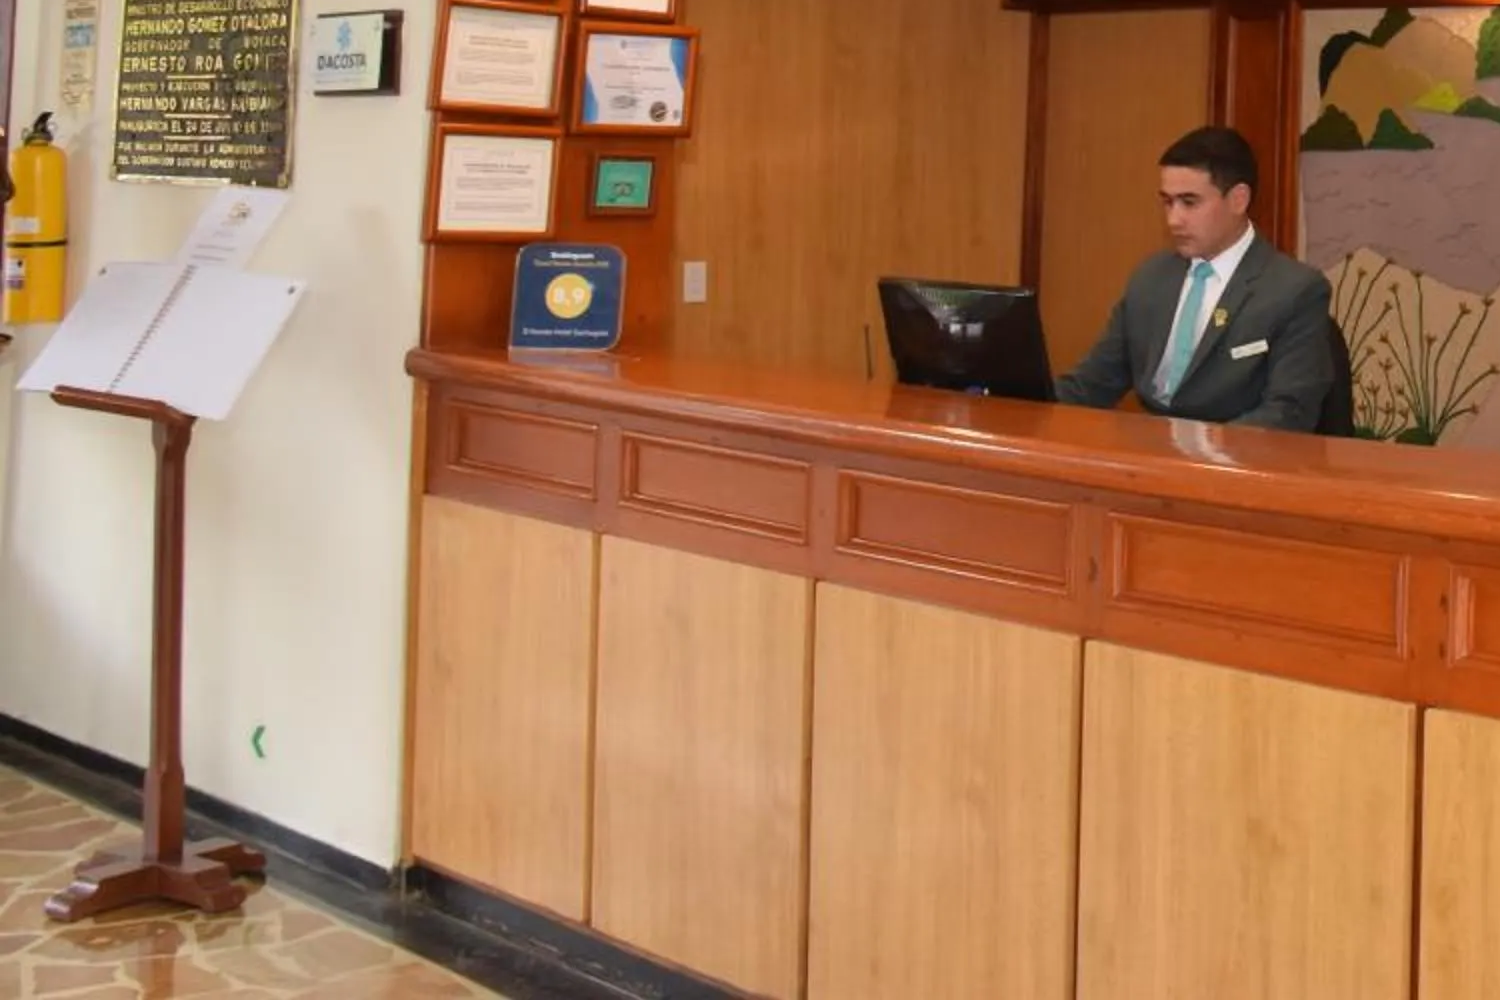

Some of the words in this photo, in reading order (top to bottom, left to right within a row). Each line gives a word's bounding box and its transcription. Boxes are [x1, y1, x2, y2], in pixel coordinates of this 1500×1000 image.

[125, 17, 185, 37] HERNANDO
[187, 14, 227, 34] GOMEZ
[231, 12, 287, 32] OTALORA
[208, 37, 223, 51] DE
[123, 55, 187, 73] ERNESTO
[195, 53, 224, 72] ROA
[317, 53, 367, 71] DACOSTA
[171, 119, 183, 134] EL
[200, 120, 213, 134] DE
